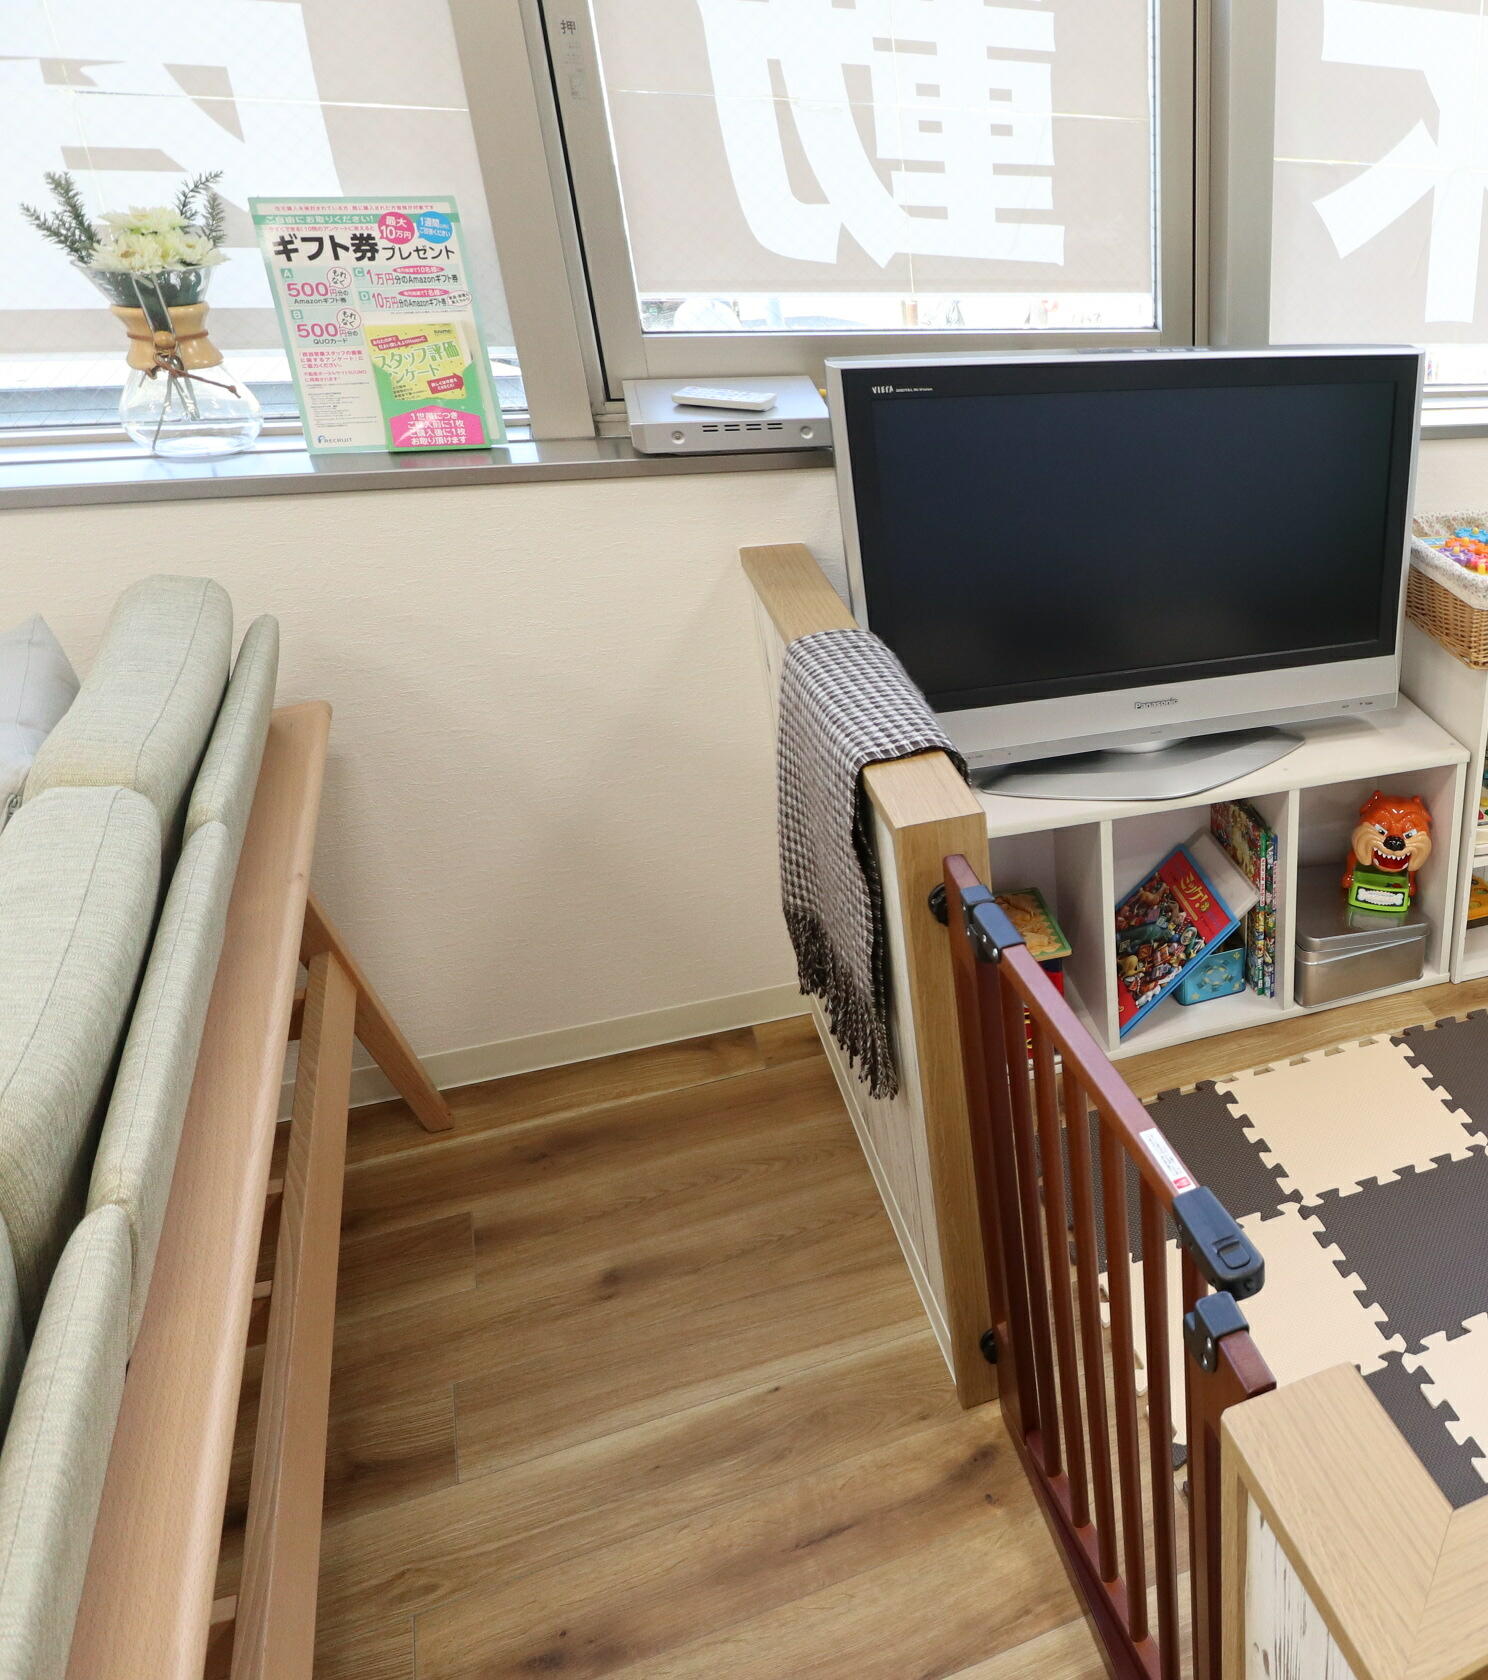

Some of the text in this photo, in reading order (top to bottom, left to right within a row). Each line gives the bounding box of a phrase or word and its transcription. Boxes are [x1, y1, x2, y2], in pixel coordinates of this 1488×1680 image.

[386, 215, 408, 228] 最大
[380, 225, 412, 239] 10万円
[391, 364, 439, 384] ンケート
[1134, 697, 1179, 710] Panasonic
